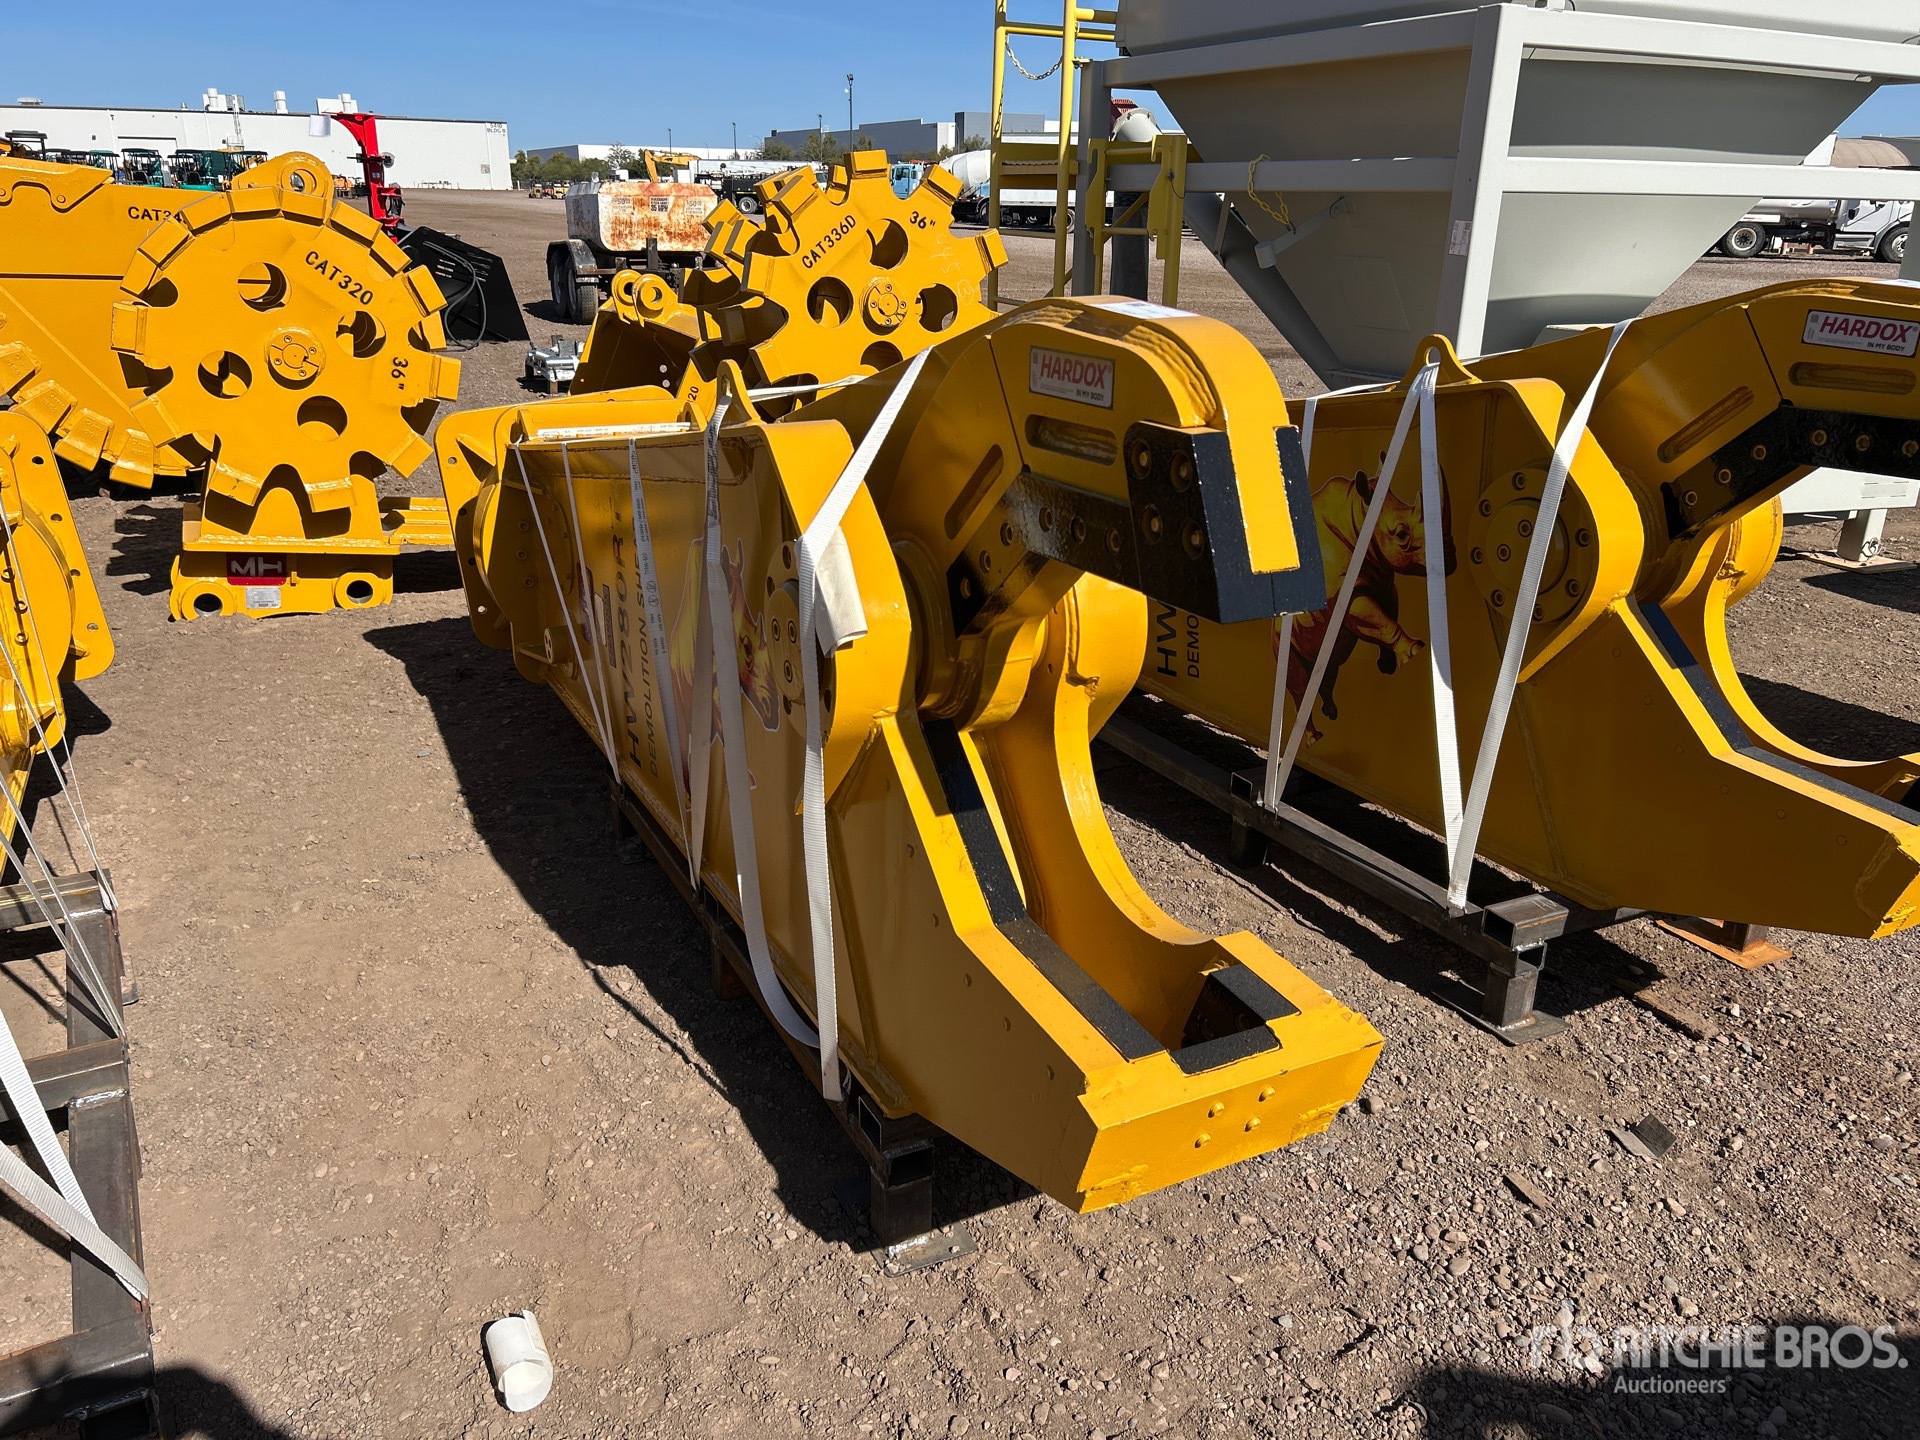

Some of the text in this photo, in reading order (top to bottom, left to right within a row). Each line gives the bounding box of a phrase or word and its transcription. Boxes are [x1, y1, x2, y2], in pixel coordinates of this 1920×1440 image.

[909, 211, 936, 230] 36"
[802, 214, 856, 269] CAT336D
[305, 250, 374, 305] CAT320
[1819, 316, 1914, 343] HARDOX
[1886, 344, 1906, 352] BODY
[391, 357, 409, 390] 36"
[1040, 354, 1108, 390] HARDOX
[1090, 392, 1105, 402] BODY
[231, 557, 283, 577] MH
[636, 619, 658, 778] DEMOLITION
